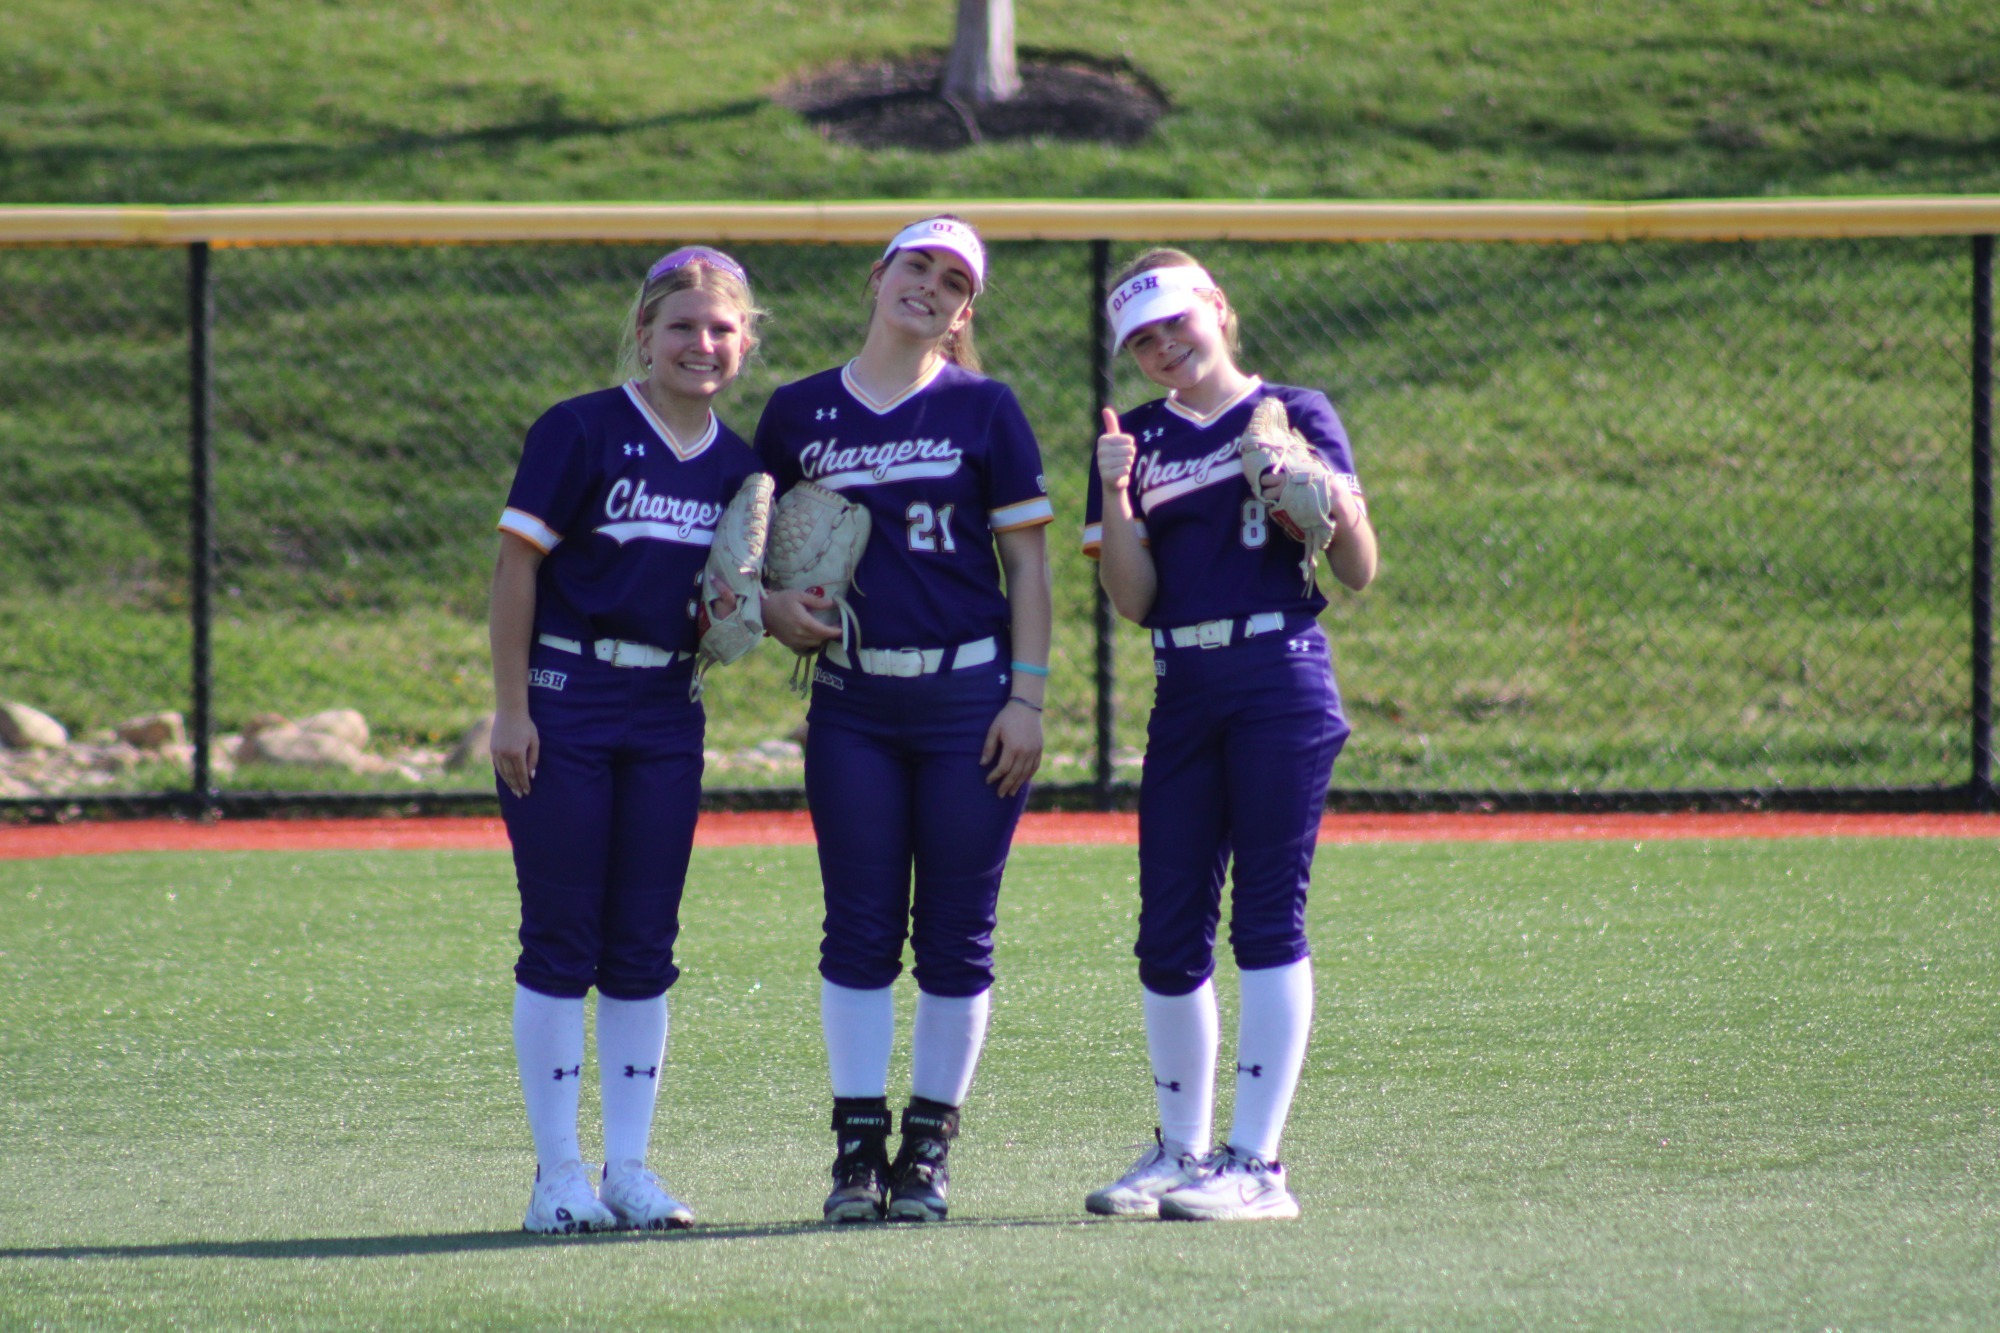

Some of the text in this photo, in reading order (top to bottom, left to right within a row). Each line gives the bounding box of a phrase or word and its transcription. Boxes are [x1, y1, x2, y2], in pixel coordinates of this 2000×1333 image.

[1113, 275, 1159, 312] OLSH
[799, 438, 961, 480] Chargers
[906, 502, 956, 552] 21
[1240, 500, 1268, 549] 8
[528, 668, 567, 691] LSH
